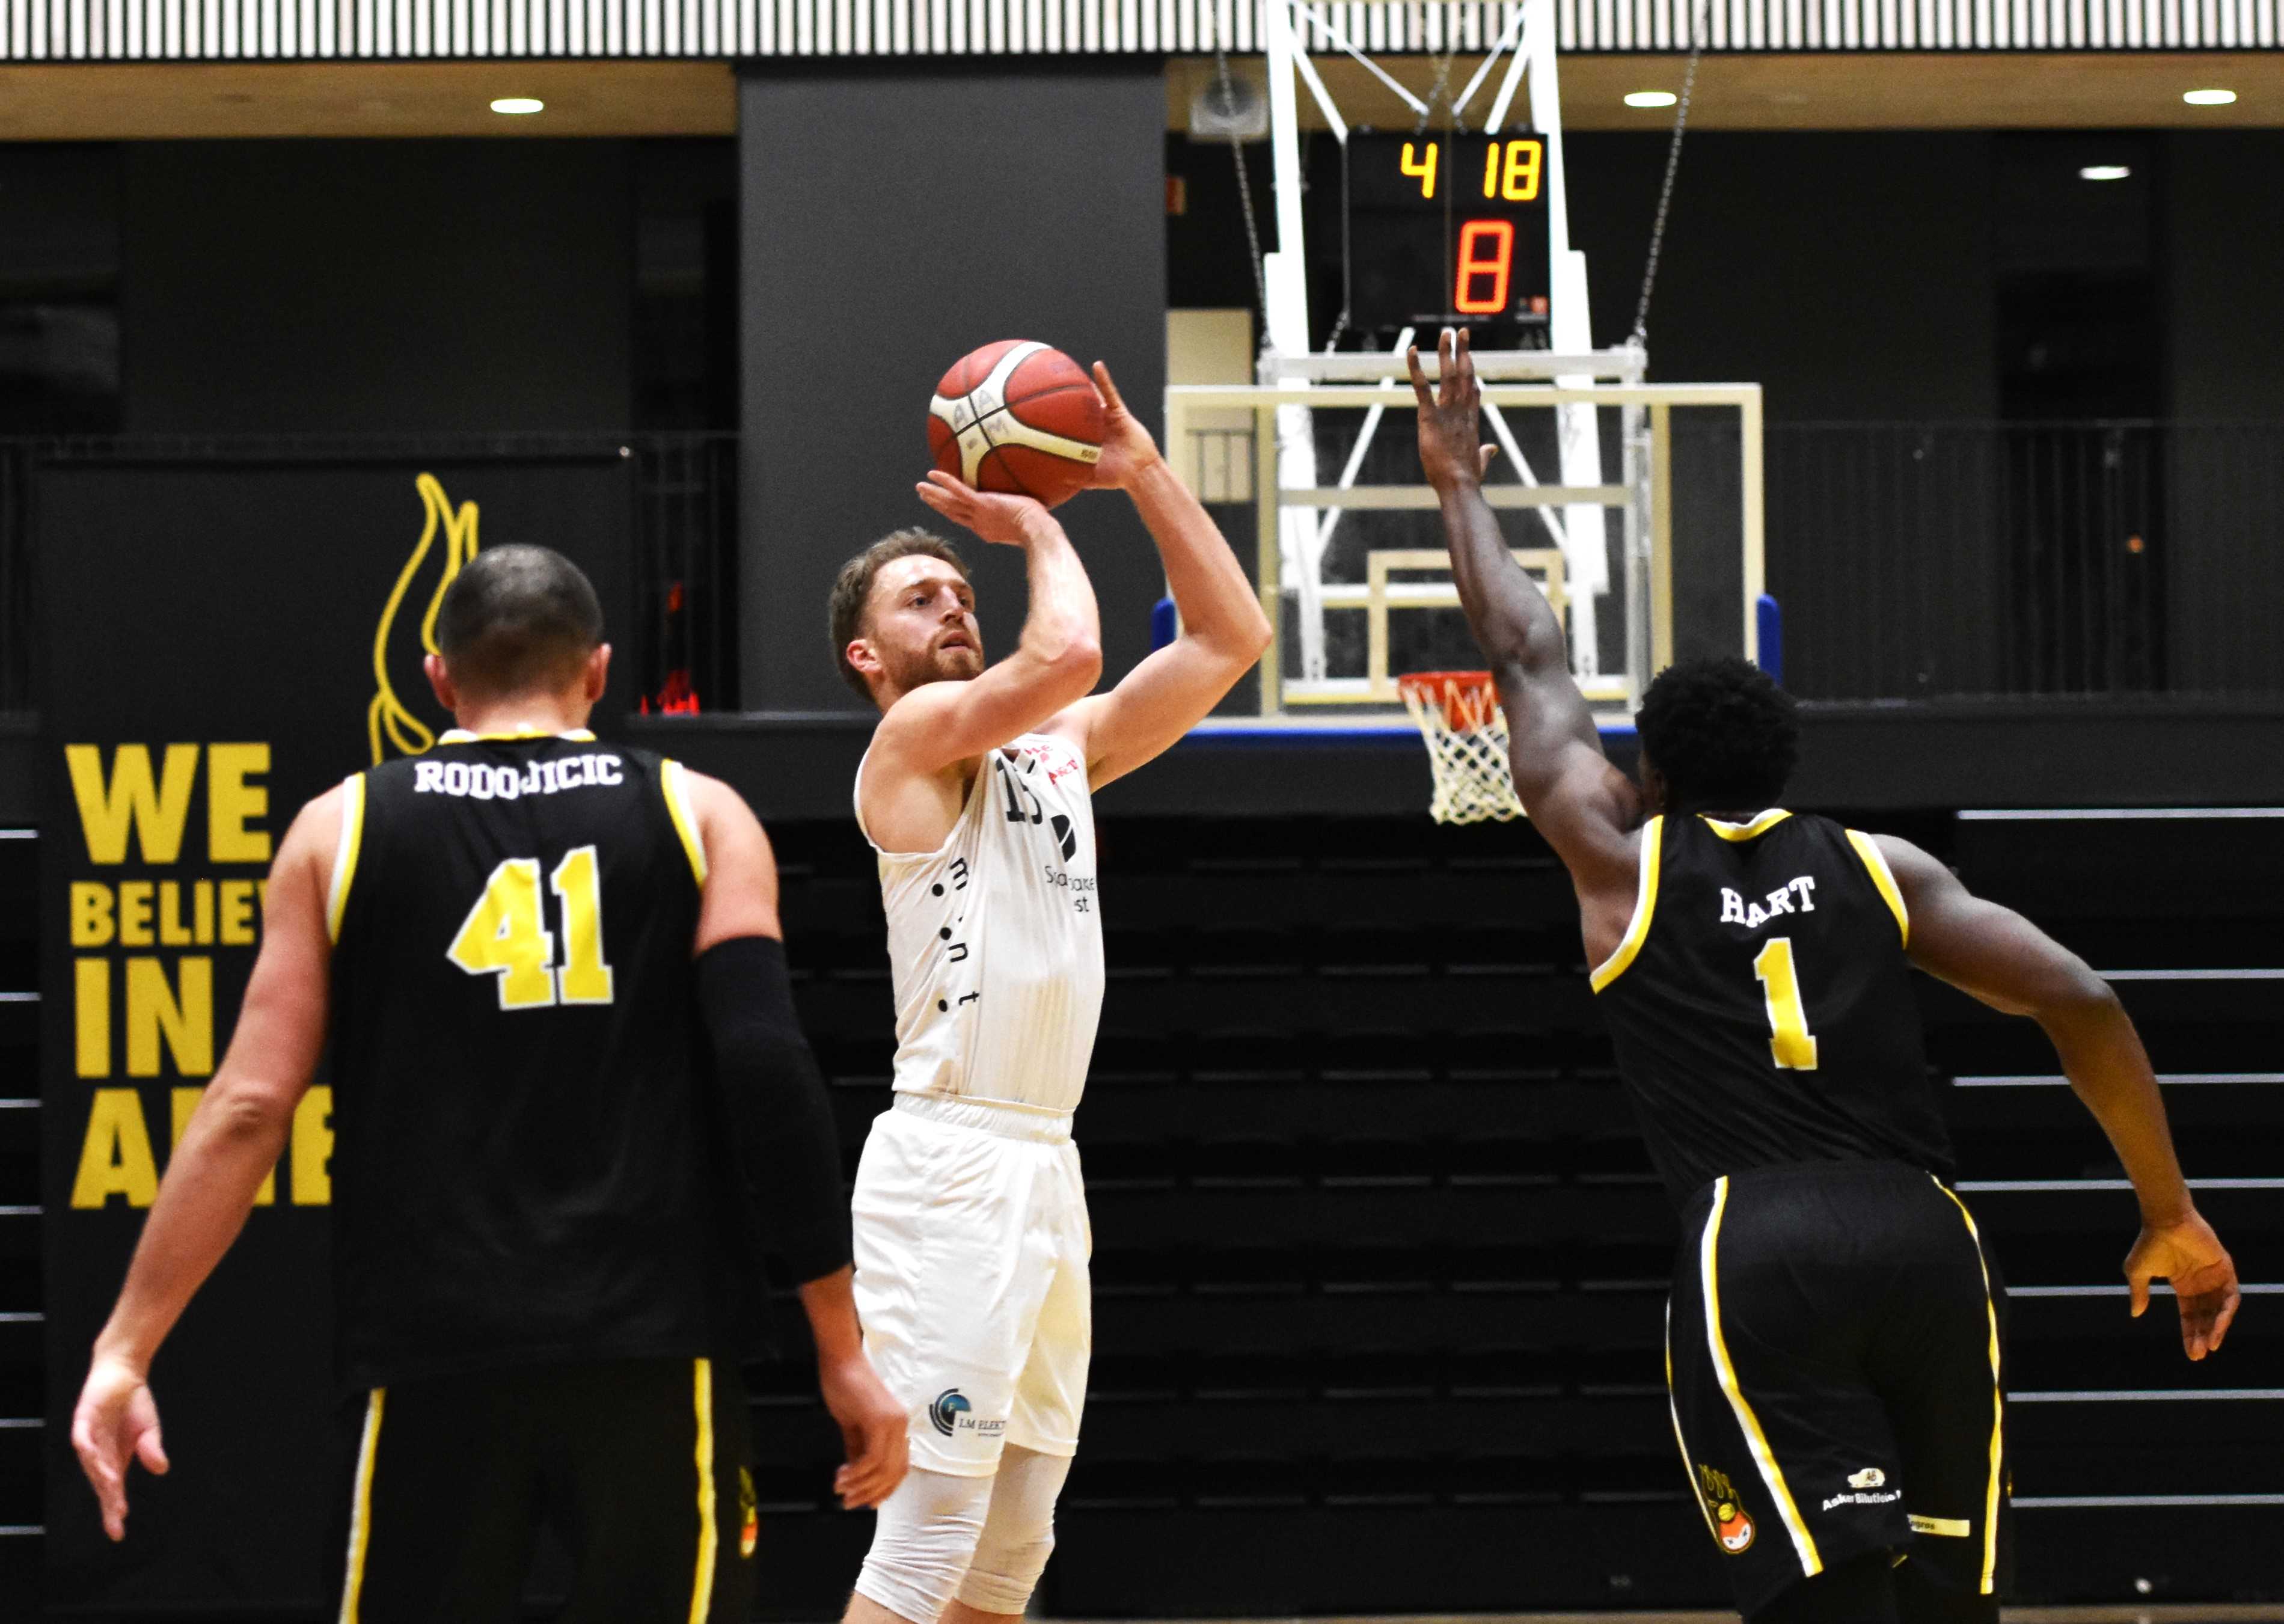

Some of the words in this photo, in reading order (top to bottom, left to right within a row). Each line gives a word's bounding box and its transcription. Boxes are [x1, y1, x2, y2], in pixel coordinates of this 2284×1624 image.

[1401, 142, 1437, 198] 4
[1484, 141, 1542, 200] 18
[1454, 220, 1513, 314] 8
[65, 743, 272, 864] WE
[414, 754, 623, 800] RODOJICIC
[70, 880, 269, 948] BELIE
[445, 844, 614, 1011] 41
[1720, 876, 1815, 928] HART
[75, 957, 213, 1078] IN
[1753, 937, 1817, 1070] 1
